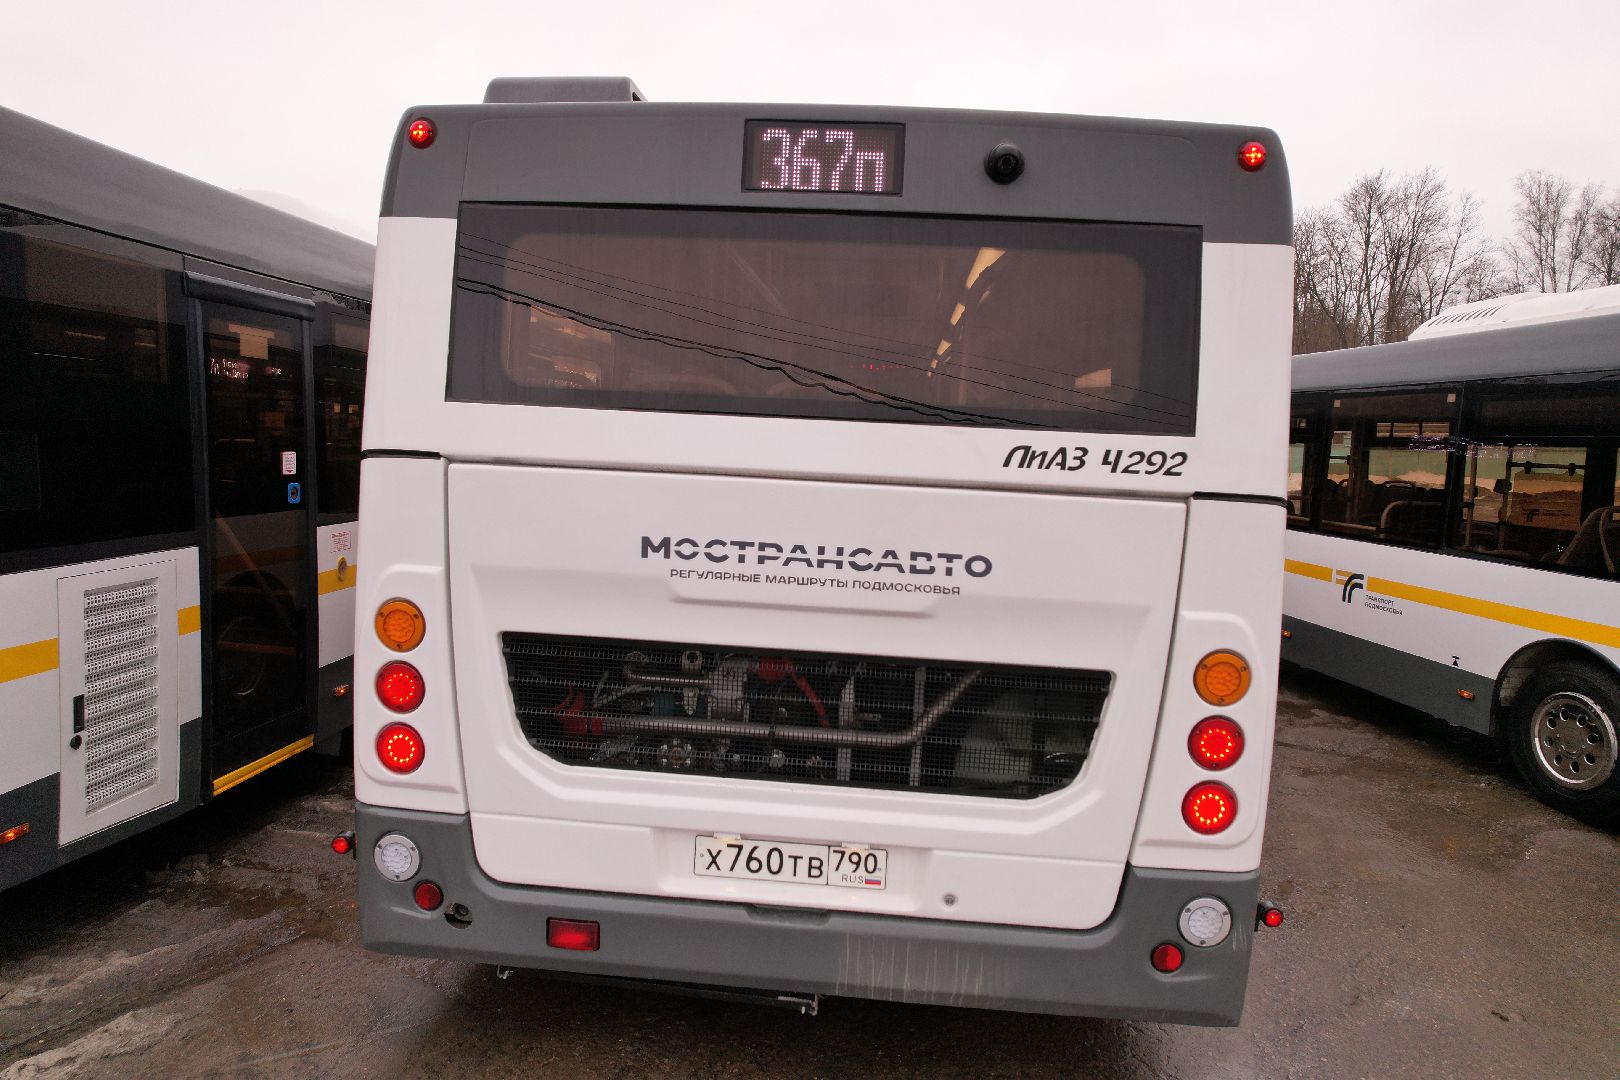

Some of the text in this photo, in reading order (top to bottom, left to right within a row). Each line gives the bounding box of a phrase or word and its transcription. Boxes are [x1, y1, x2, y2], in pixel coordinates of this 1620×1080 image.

[1002, 444, 1188, 477] ЛиАЗ 4292
[641, 535, 993, 578] МОСТРАНСАВТО
[670, 568, 960, 595] РЕГУЛЯРНЫЕ МАРШРУТЫ ПОДМОСКОВЬЯ
[833, 850, 877, 874] 790
[841, 874, 864, 884] RUS
